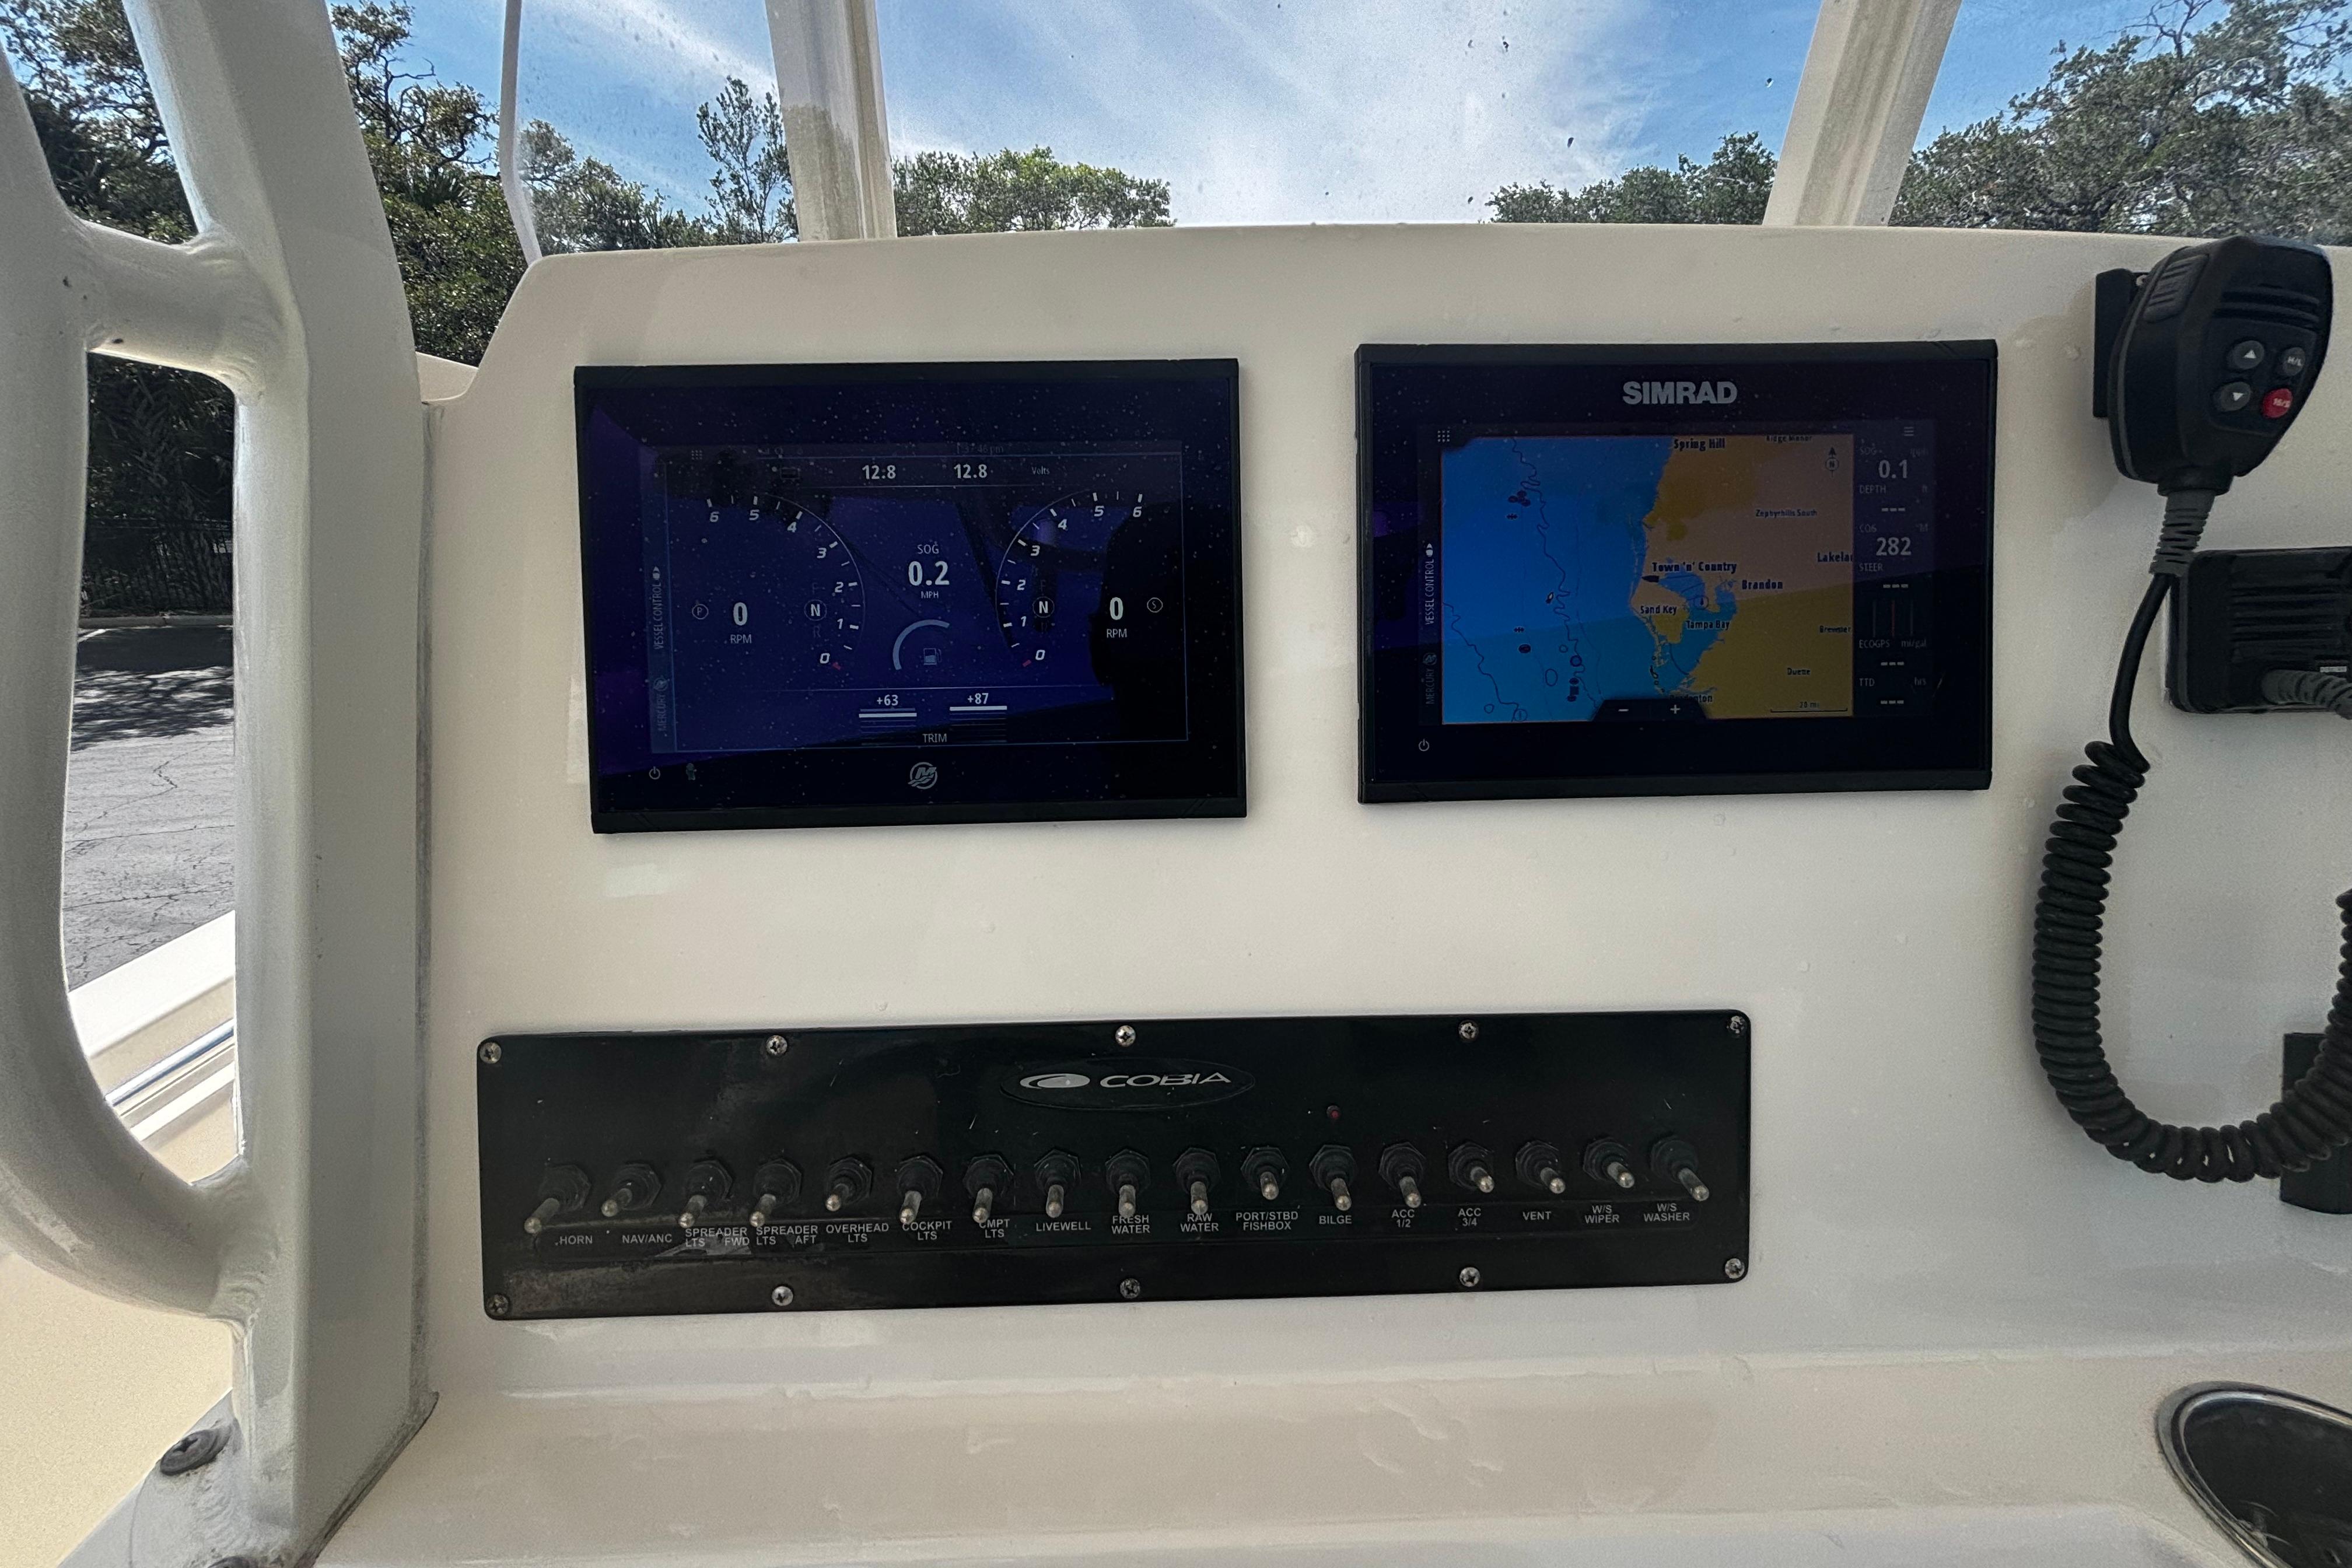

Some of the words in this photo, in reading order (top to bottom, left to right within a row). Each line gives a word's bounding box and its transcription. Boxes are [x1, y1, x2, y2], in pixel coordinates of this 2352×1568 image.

[1622, 380, 1738, 405] SIMRAD
[1674, 438, 1706, 451] Spring
[1709, 438, 1725, 449] Hill
[862, 464, 897, 480] 12.8
[953, 464, 988, 479] 12.8
[1031, 466, 1050, 475] Volts
[1878, 459, 1908, 478] 0.1
[1859, 485, 1887, 494] DEPTH
[709, 511, 719, 522] 6
[748, 509, 760, 521] 5
[1094, 506, 1104, 517] 5
[1133, 506, 1142, 517] 6
[786, 522, 797, 533] 4
[1058, 519, 1068, 530] 4
[916, 544, 939, 554] SOG
[1030, 545, 1040, 556] 3
[1876, 537, 1912, 556] 282
[817, 548, 827, 559] 3
[1652, 562, 1679, 572] Town
[1699, 562, 1737, 573] Country
[1859, 563, 1884, 572] STEER
[908, 561, 950, 586] 0.2
[1425, 559, 1434, 597] CONTROL
[835, 582, 844, 593] 2
[1017, 579, 1026, 590] 2
[1742, 579, 1783, 589] Brandon
[921, 591, 939, 599] MPH
[653, 582, 663, 621] CONTROL
[811, 604, 821, 617] N
[1039, 601, 1048, 614] N
[1110, 597, 1124, 620] 0
[1425, 598, 1434, 625] VESSEL
[1640, 606, 1660, 614] Sand
[1662, 606, 1677, 615] Key
[733, 602, 748, 626] 0
[837, 618, 844, 629] 1
[1021, 616, 1027, 627] 1
[1685, 620, 1713, 631] Tampa
[1716, 620, 1730, 630] Bay
[653, 622, 664, 650] VESSEL
[1107, 628, 1128, 638] RPM
[730, 634, 752, 644] RPM
[1859, 639, 1890, 649] ECOGPS
[820, 653, 831, 664] 0
[1035, 650, 1046, 660] 0
[1425, 668, 1434, 705] MERCURY
[1859, 678, 1875, 687] TTD
[1914, 677, 1927, 686] hrs
[877, 694, 899, 706] +63
[967, 692, 989, 705] +87
[923, 733, 947, 743] TRIM
[1100, 1072, 1231, 1088] COBIA
[1458, 1208, 1482, 1217] ACC
[1592, 1205, 1612, 1214] W/S
[1657, 1203, 1677, 1213] W/S
[1112, 1214, 1149, 1224] FRESH
[1187, 1213, 1213, 1222] RAW
[1236, 1212, 1298, 1222] PORT/STBD
[1391, 1209, 1415, 1219] ACC
[1522, 1211, 1552, 1220] VENT
[1584, 1214, 1620, 1224] WIPER
[1644, 1212, 1690, 1222] WASHER
[1319, 1215, 1352, 1224] BILGE
[1396, 1219, 1410, 1228] 1/2
[1462, 1217, 1477, 1227] 3/4
[756, 1226, 818, 1236] SPREADER
[826, 1223, 889, 1234] OVERHEAD
[902, 1221, 953, 1231] COCKPIT
[1036, 1222, 1091, 1232] LIVEWELL
[1111, 1224, 1150, 1234] WATER
[1180, 1223, 1219, 1232] WATER
[1243, 1222, 1292, 1231] FISHBOX
[685, 1227, 747, 1237] SPREADER
[918, 1231, 937, 1241] LTS
[985, 1228, 1005, 1238] LTS
[559, 1235, 593, 1245] HORN
[622, 1234, 672, 1244] NAV/ANC
[685, 1237, 705, 1247] LTS
[725, 1237, 750, 1247] FWD
[757, 1236, 776, 1245] LTS
[795, 1235, 817, 1245] AFT
[848, 1233, 867, 1242] LTS
